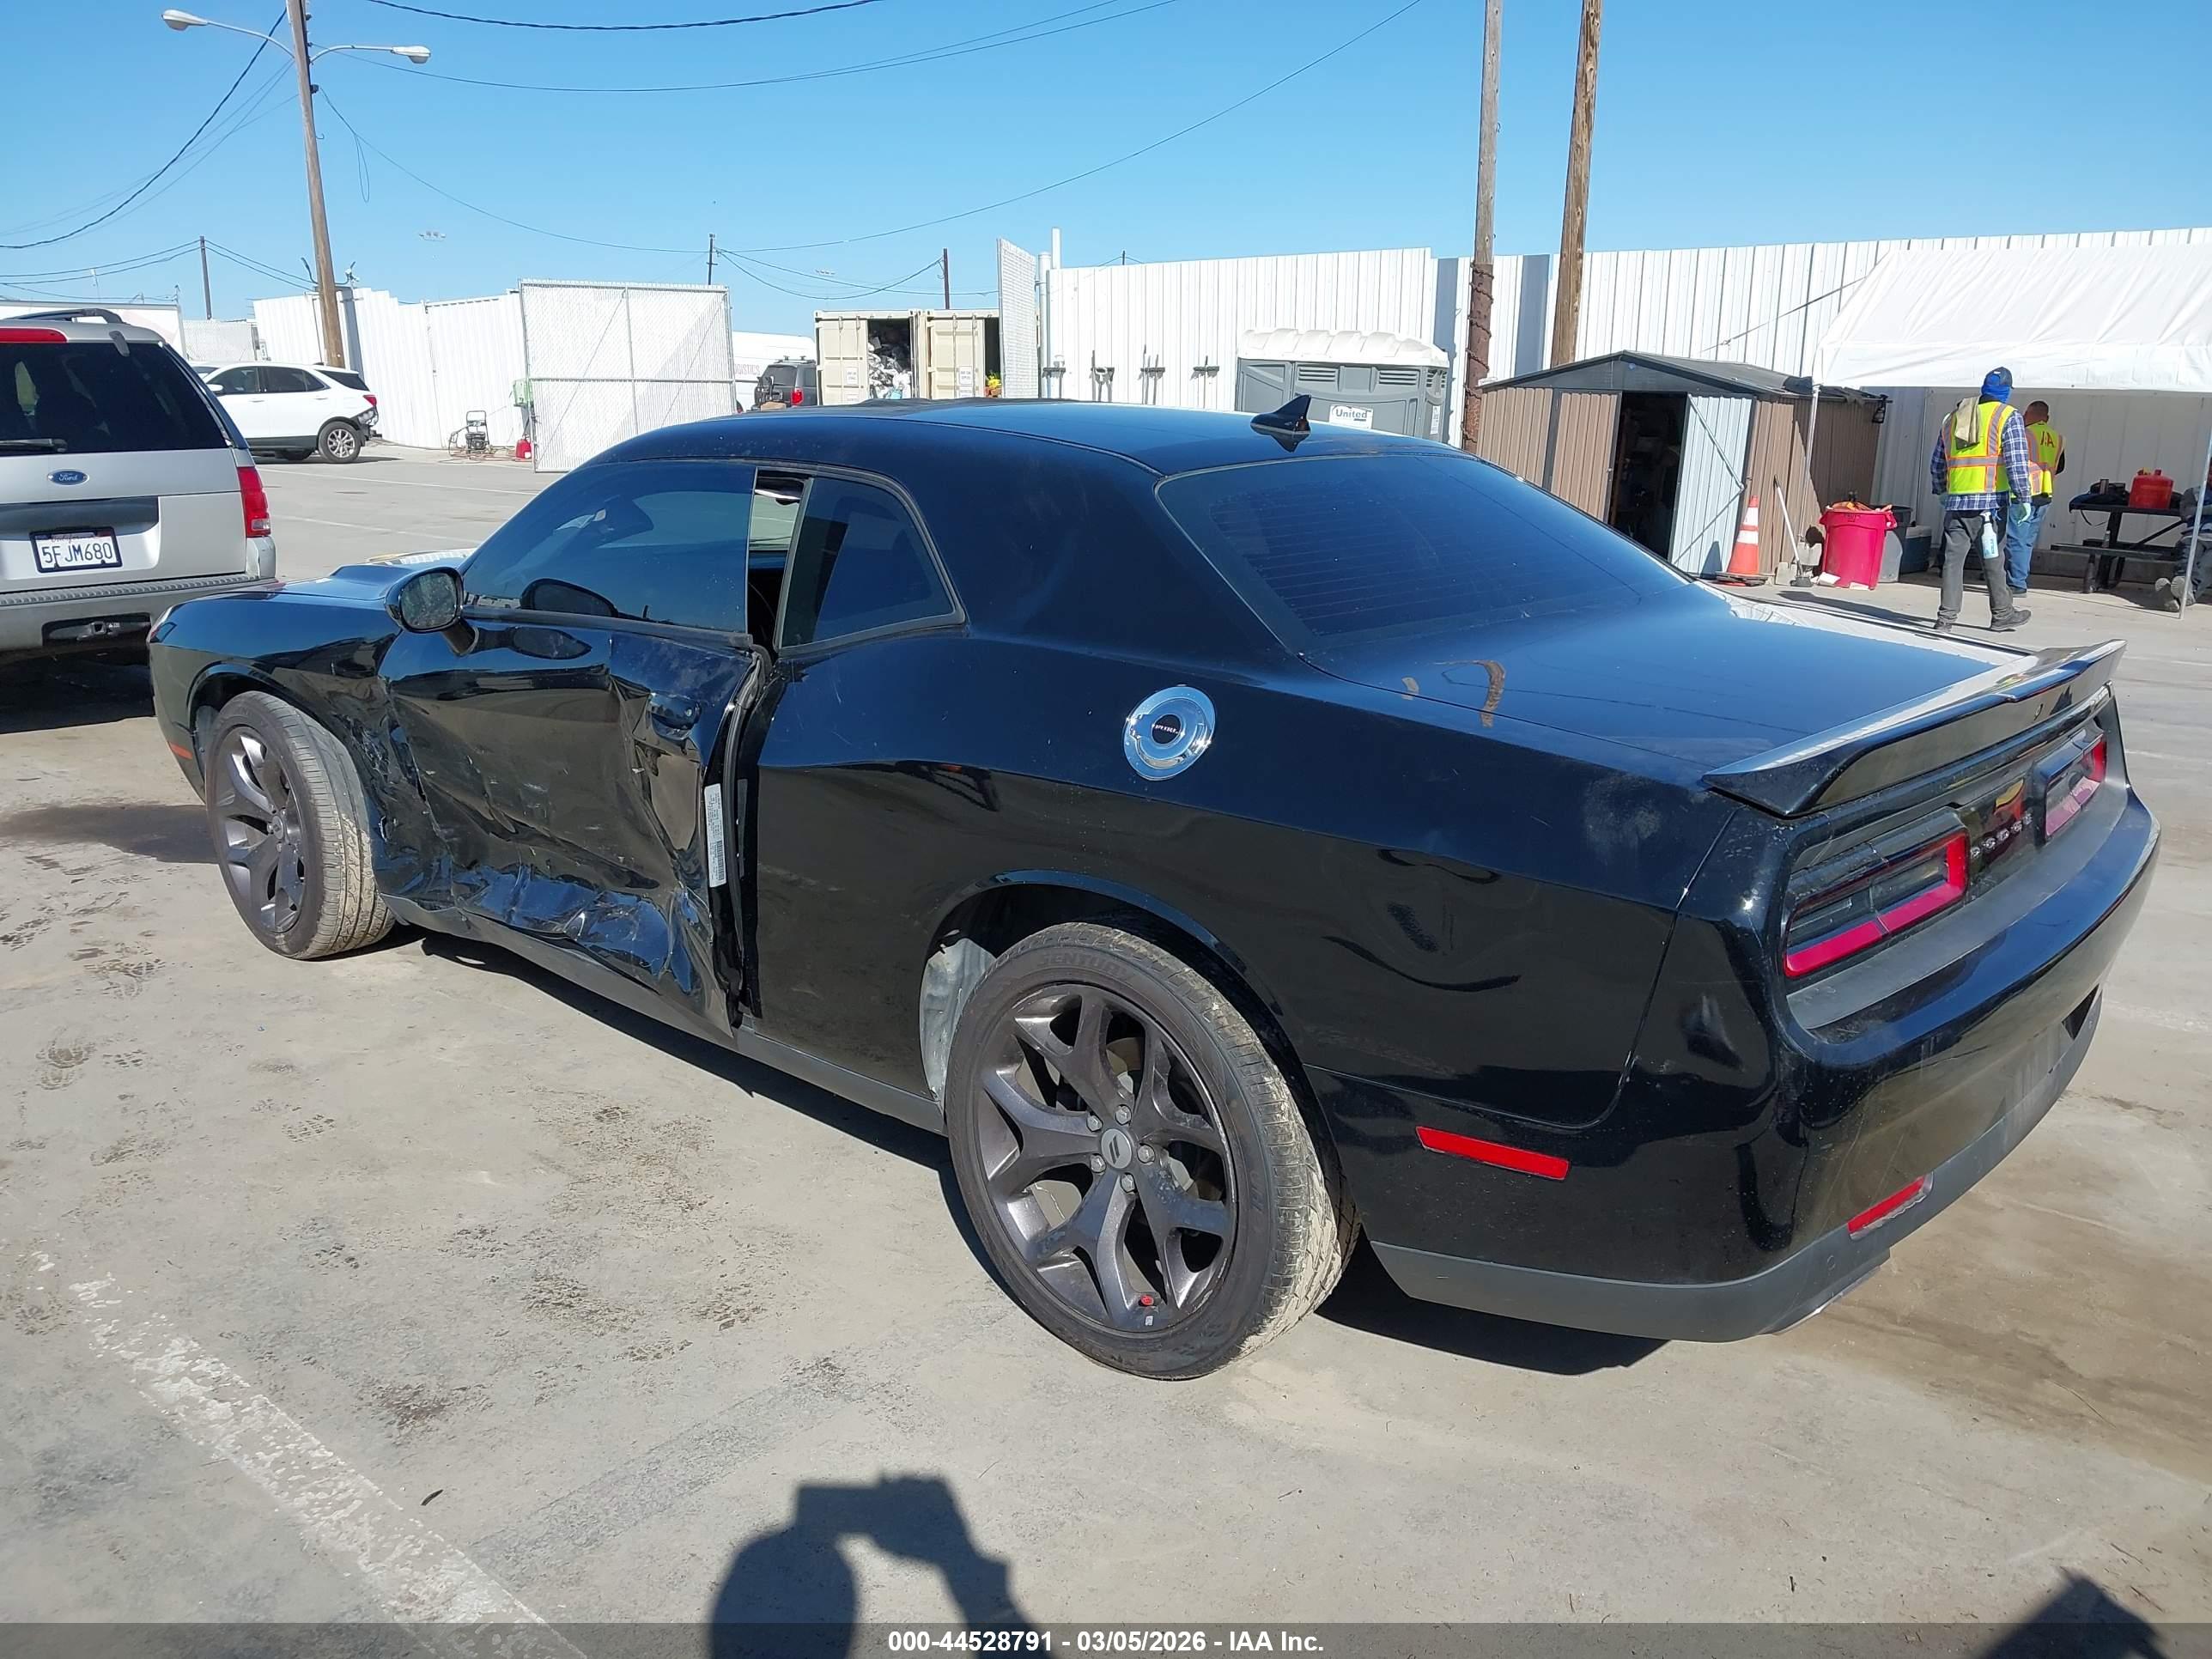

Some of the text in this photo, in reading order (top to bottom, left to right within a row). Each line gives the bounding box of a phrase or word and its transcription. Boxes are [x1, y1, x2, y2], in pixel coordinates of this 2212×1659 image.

[1335, 408, 1368, 418] United
[58, 473, 78, 482] Ford
[41, 542, 113, 564] 5FJM680
